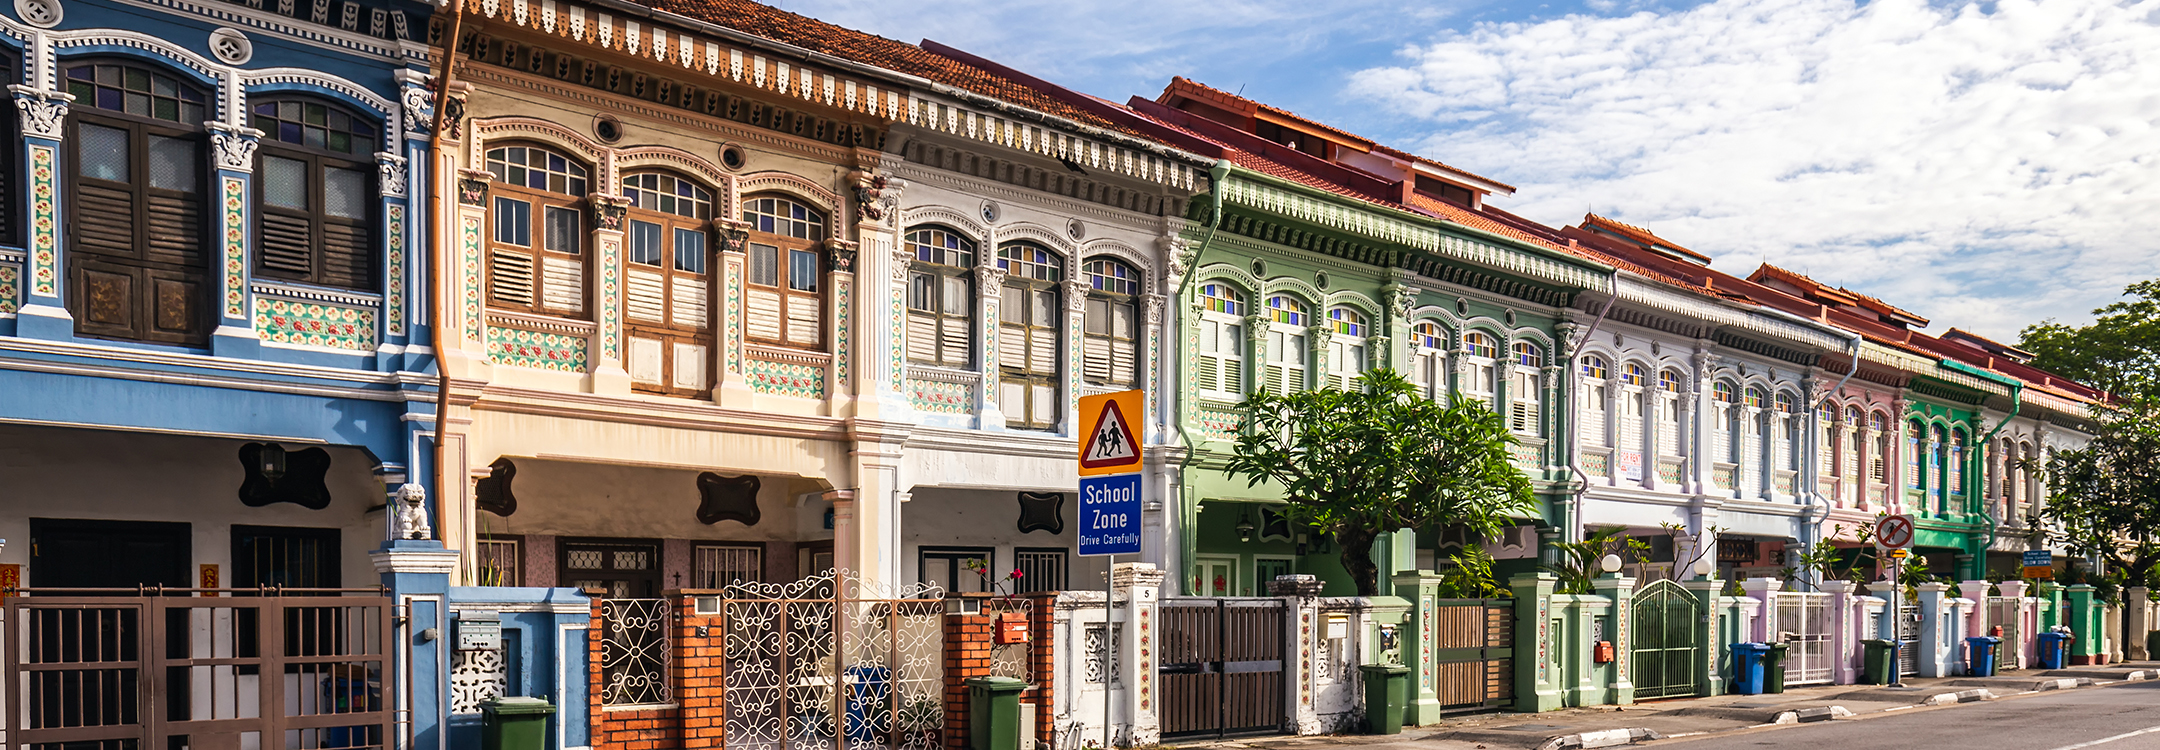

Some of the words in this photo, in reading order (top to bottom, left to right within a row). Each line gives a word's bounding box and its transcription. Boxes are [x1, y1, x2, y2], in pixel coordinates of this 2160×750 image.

[1621, 451, 1629, 461] FOR
[1630, 453, 1641, 463] RENT
[1086, 481, 1135, 505] School
[1092, 509, 1128, 530] Zone
[1080, 534, 1100, 546] Drive
[1103, 532, 1140, 546] Carefully
[1144, 589, 1150, 598] 5
[699, 625, 708, 637] 3
[463, 636, 468, 645] 1
